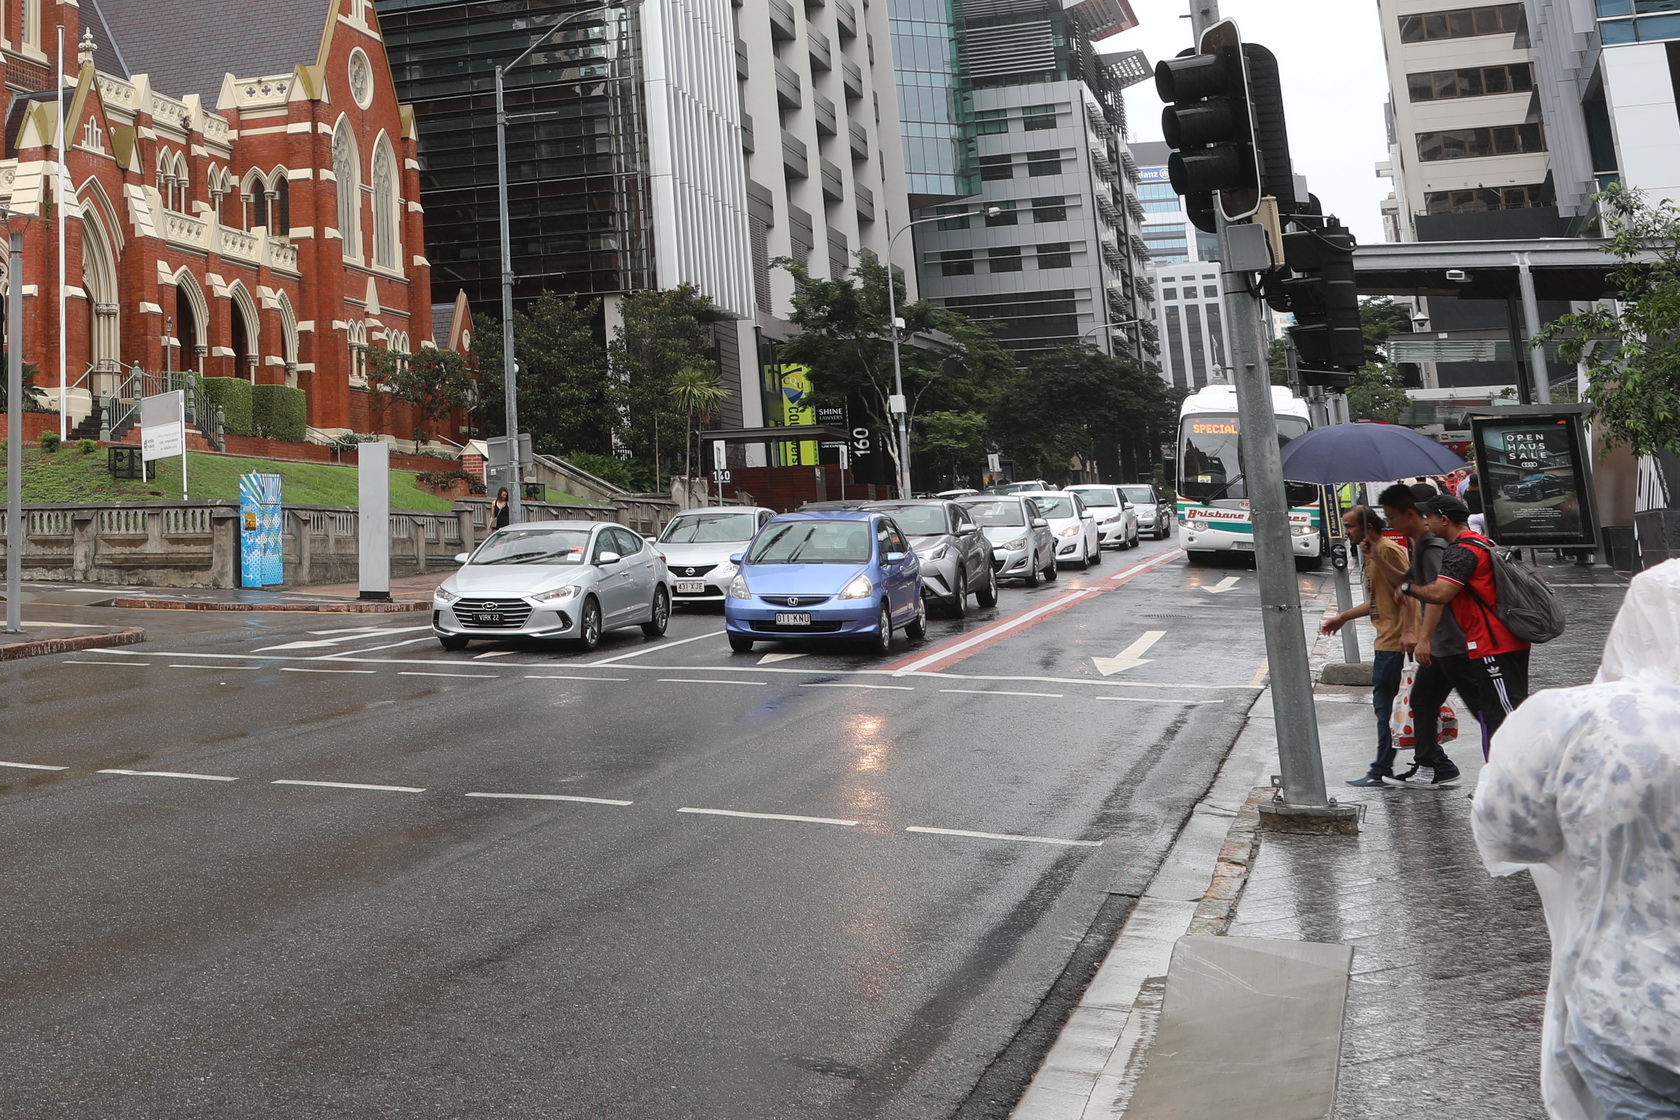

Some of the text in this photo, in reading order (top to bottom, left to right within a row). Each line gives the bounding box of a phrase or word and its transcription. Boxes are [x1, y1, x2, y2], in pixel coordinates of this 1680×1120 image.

[783, 376, 804, 390] CQU
[819, 408, 843, 416] SHINE
[1192, 424, 1238, 434] SPECIAL
[1506, 433, 1544, 441] OPEN
[852, 427, 871, 458] 160
[1508, 442, 1546, 451] HAUS
[1509, 451, 1548, 460] SALE
[1187, 509, 1245, 519] Brisbane
